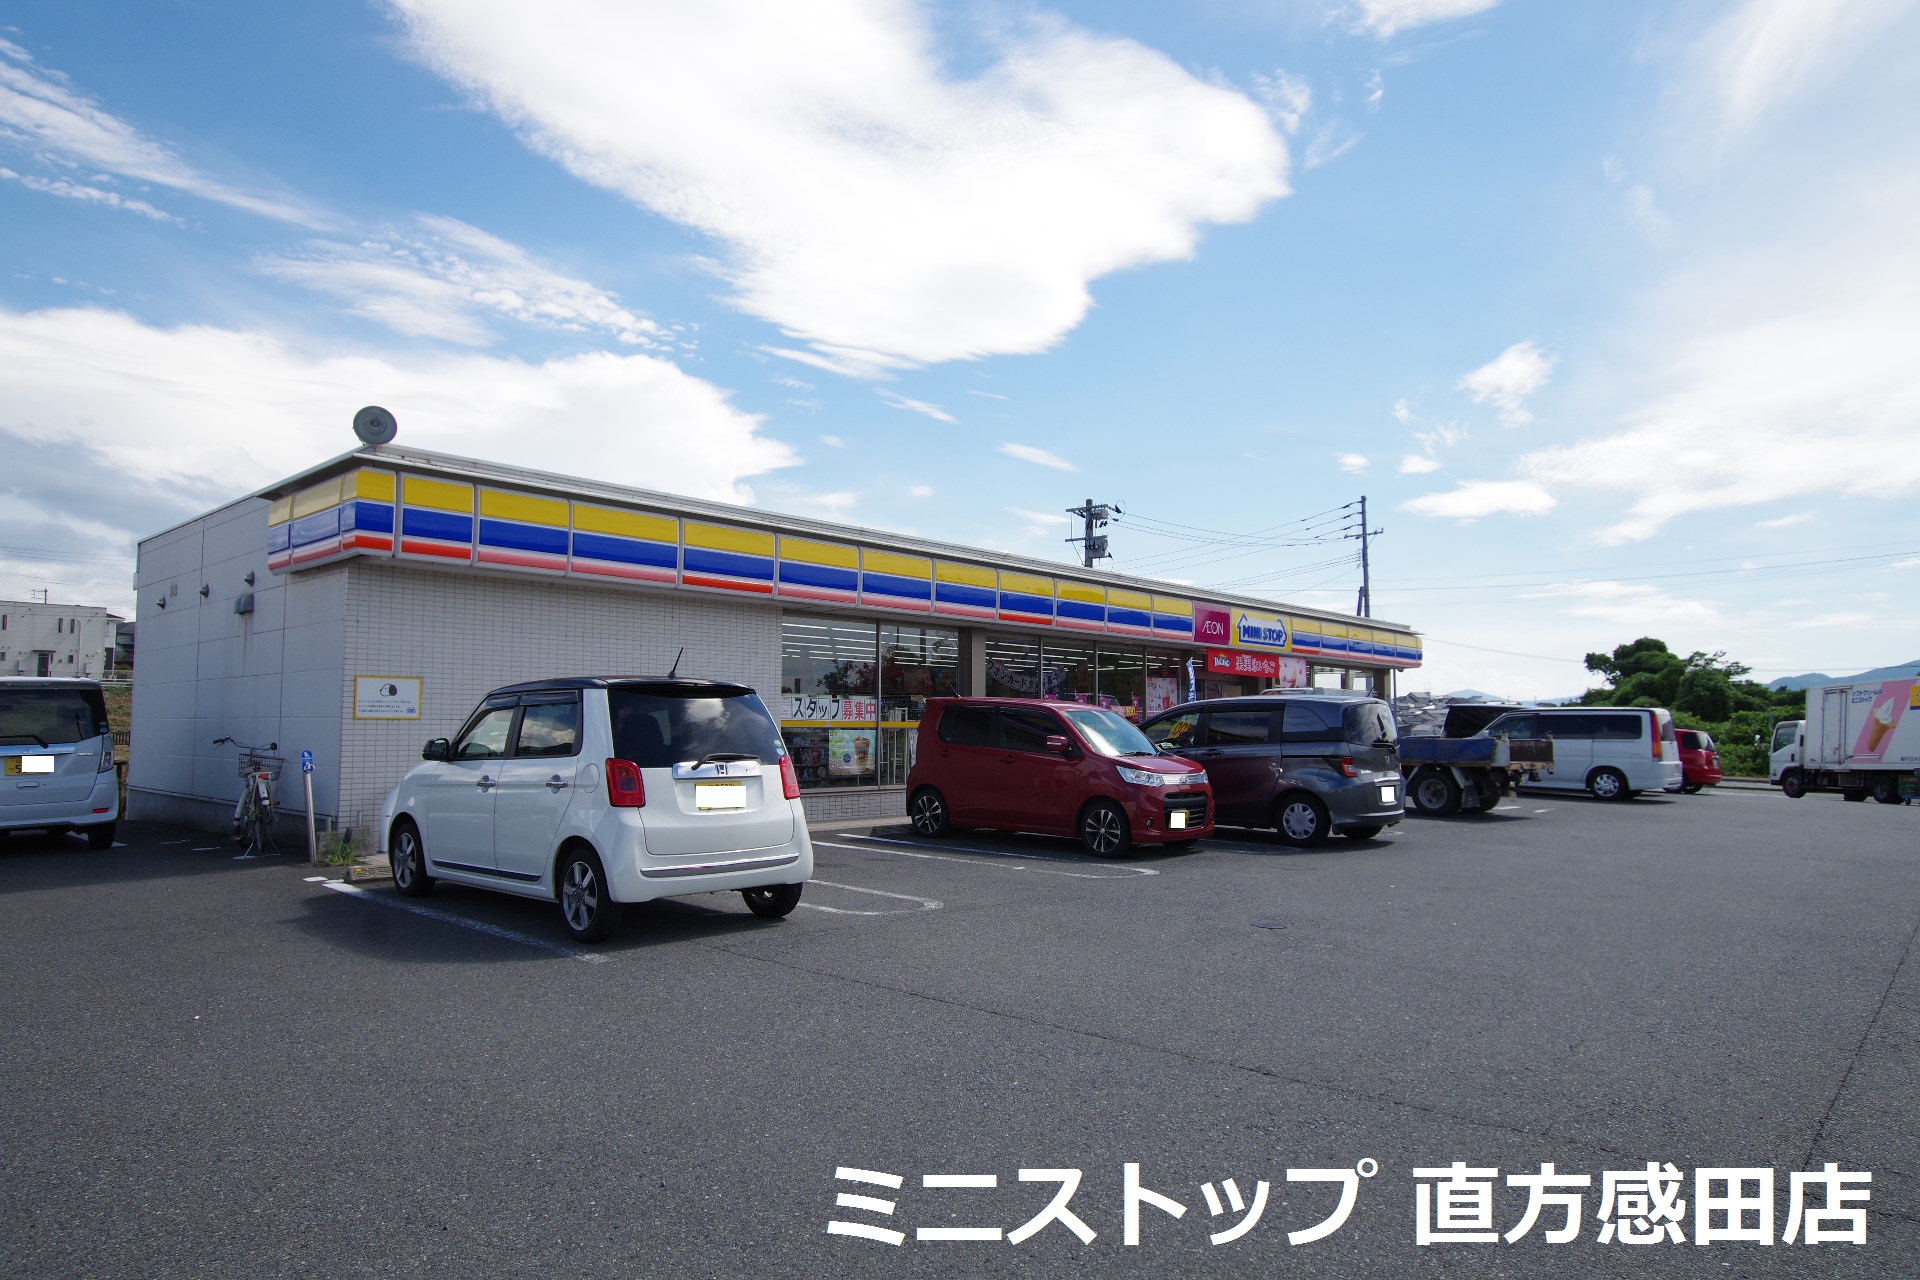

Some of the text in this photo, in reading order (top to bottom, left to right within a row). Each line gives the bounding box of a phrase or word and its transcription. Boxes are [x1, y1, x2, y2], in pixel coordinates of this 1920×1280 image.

[1242, 624, 1284, 643] MINI STOP
[793, 697, 876, 720] スタッフ募集中
